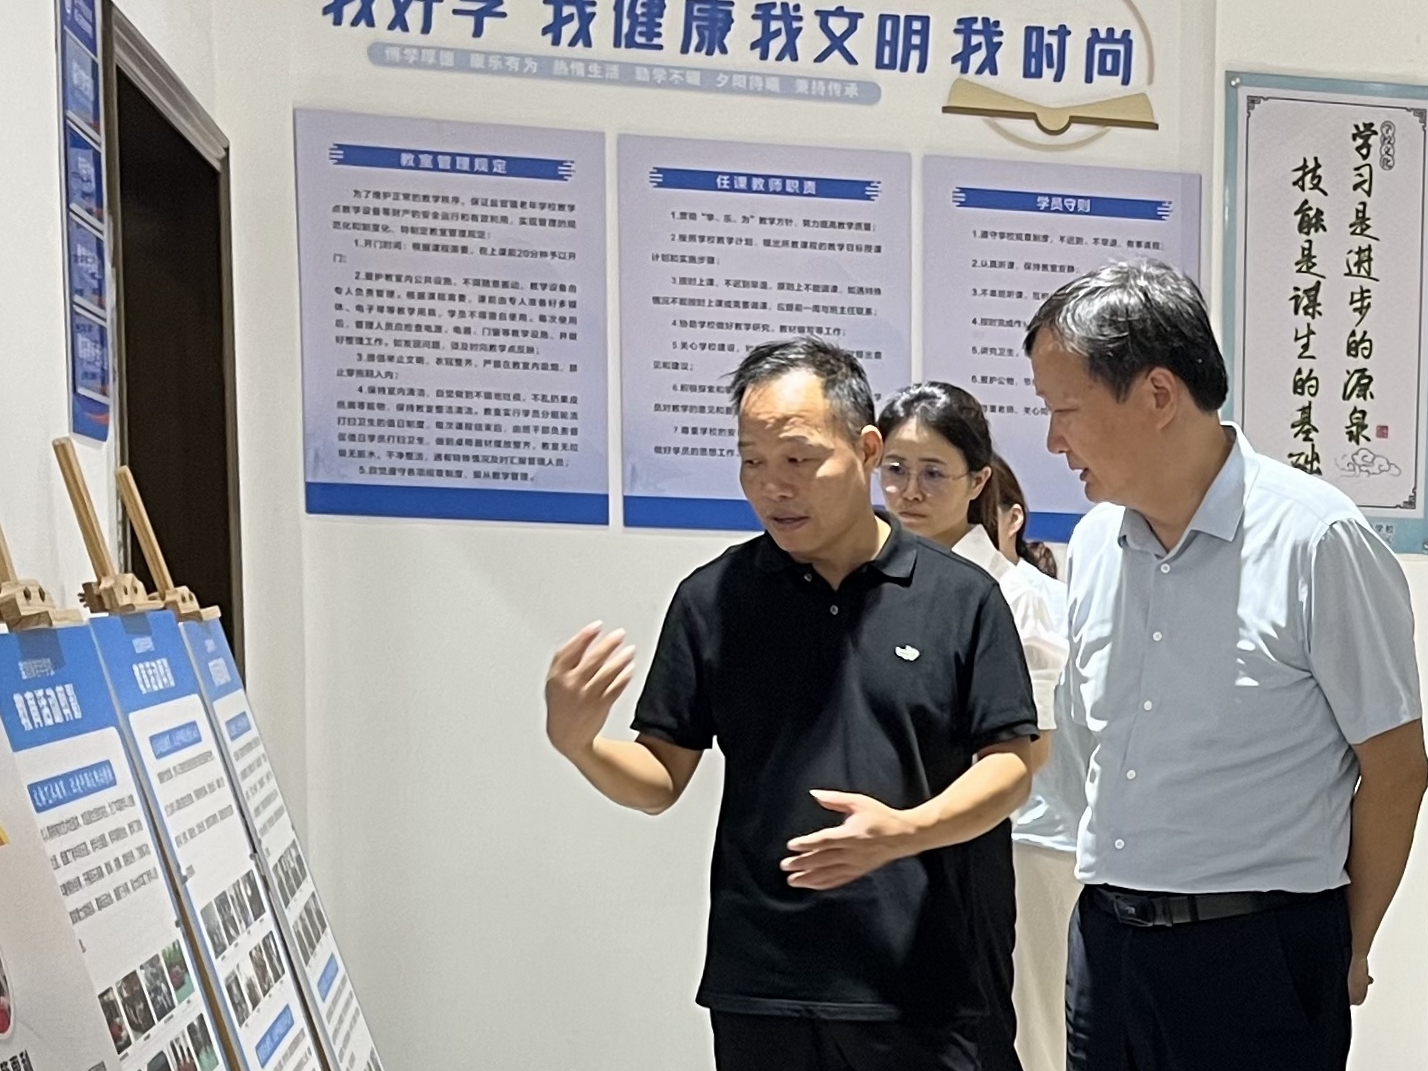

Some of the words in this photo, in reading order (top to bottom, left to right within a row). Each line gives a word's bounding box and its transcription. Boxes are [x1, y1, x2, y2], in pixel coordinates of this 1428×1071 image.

[400, 152, 508, 174] 教室管理规定
[716, 174, 818, 196] 任课教师职责
[1036, 195, 1092, 213] 学员守则
[1342, 121, 1381, 446] 学习是进步的源泉
[1287, 155, 1329, 476] 技能是谋生的基础
